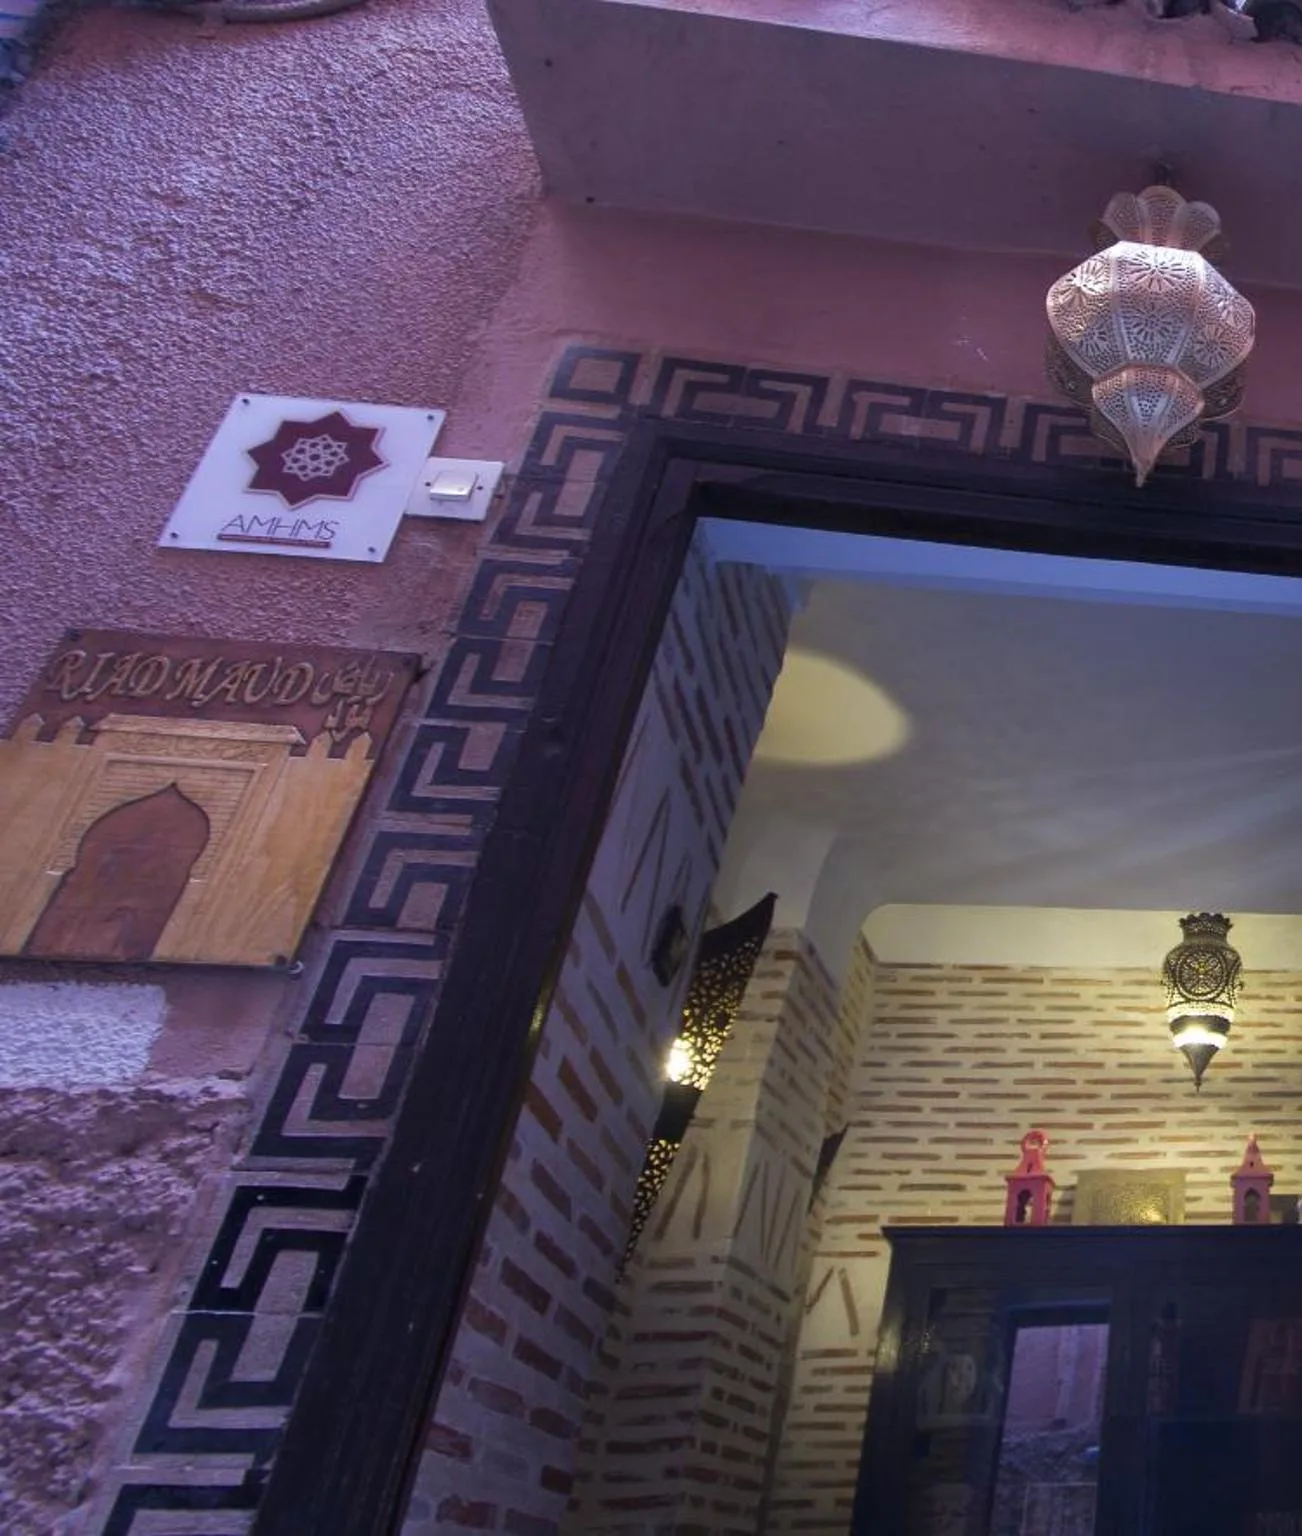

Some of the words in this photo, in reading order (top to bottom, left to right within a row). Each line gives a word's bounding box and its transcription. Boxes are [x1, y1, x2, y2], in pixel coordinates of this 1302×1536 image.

[221, 514, 339, 540] AMHMS
[50, 650, 170, 700] RIAD
[166, 657, 315, 706] MAUD
